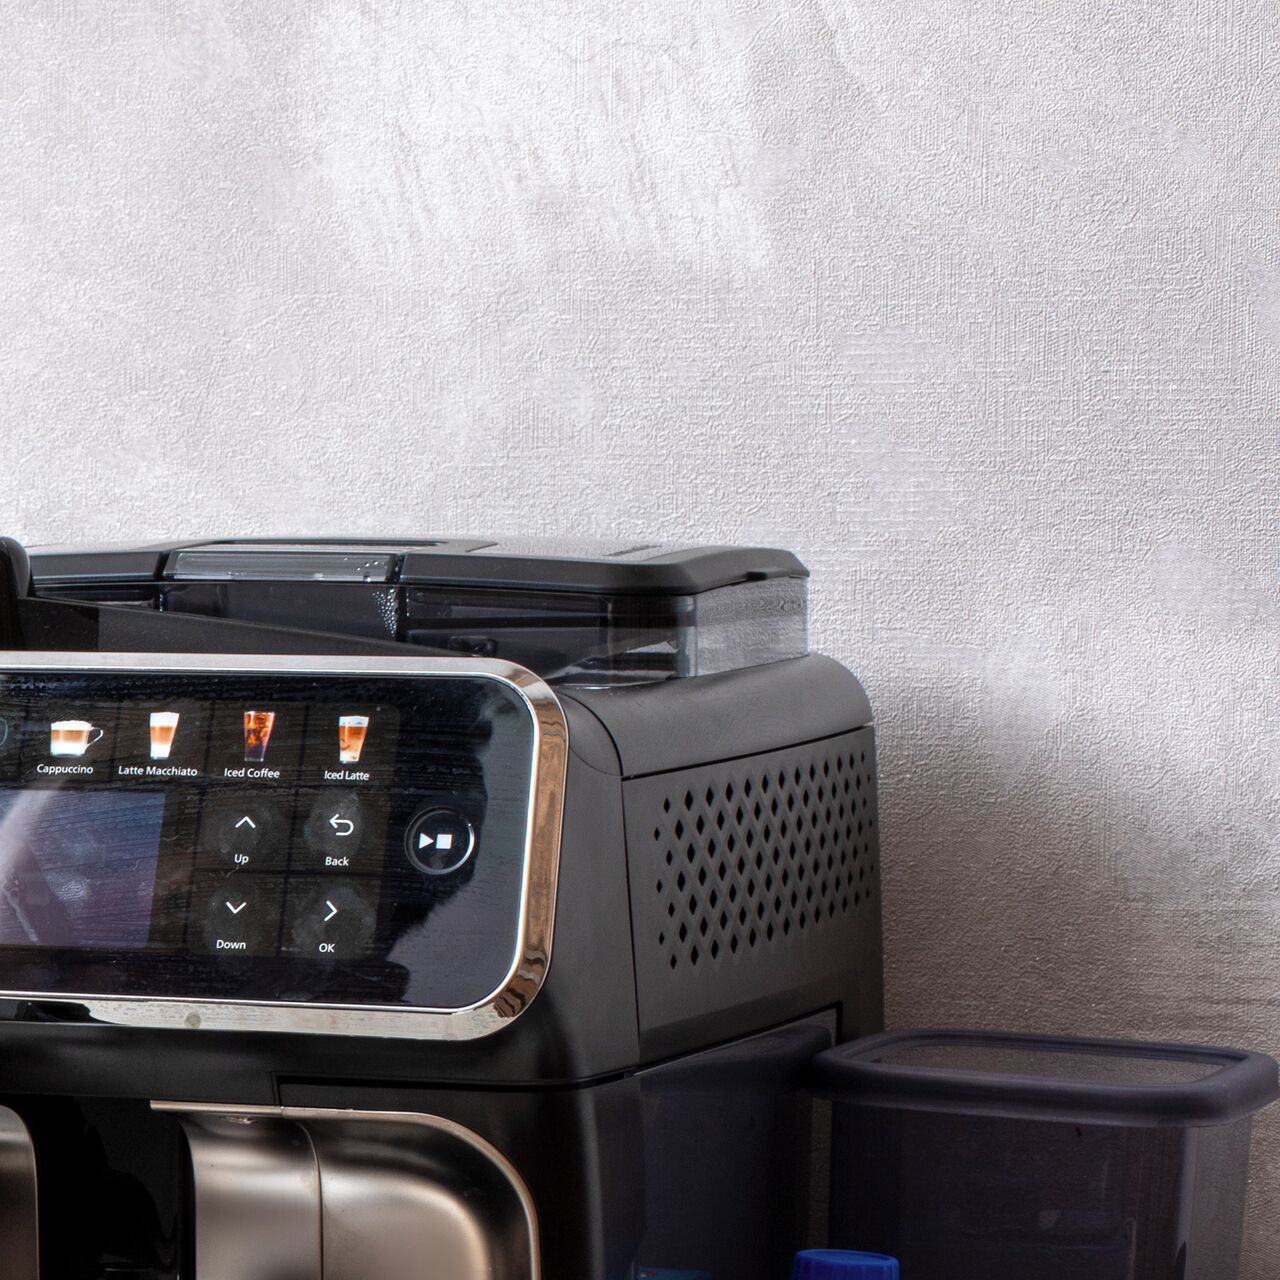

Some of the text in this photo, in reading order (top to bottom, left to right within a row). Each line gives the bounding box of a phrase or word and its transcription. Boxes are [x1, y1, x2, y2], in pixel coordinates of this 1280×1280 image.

[36, 763, 94, 776] Cappuccino
[118, 765, 198, 777] Latte Macchiato
[224, 767, 280, 779] Iced Coffee
[324, 769, 370, 781] Iced Latte
[234, 853, 250, 865] Up
[325, 856, 350, 867] Back
[216, 939, 247, 950] Down
[319, 943, 336, 953] OK
